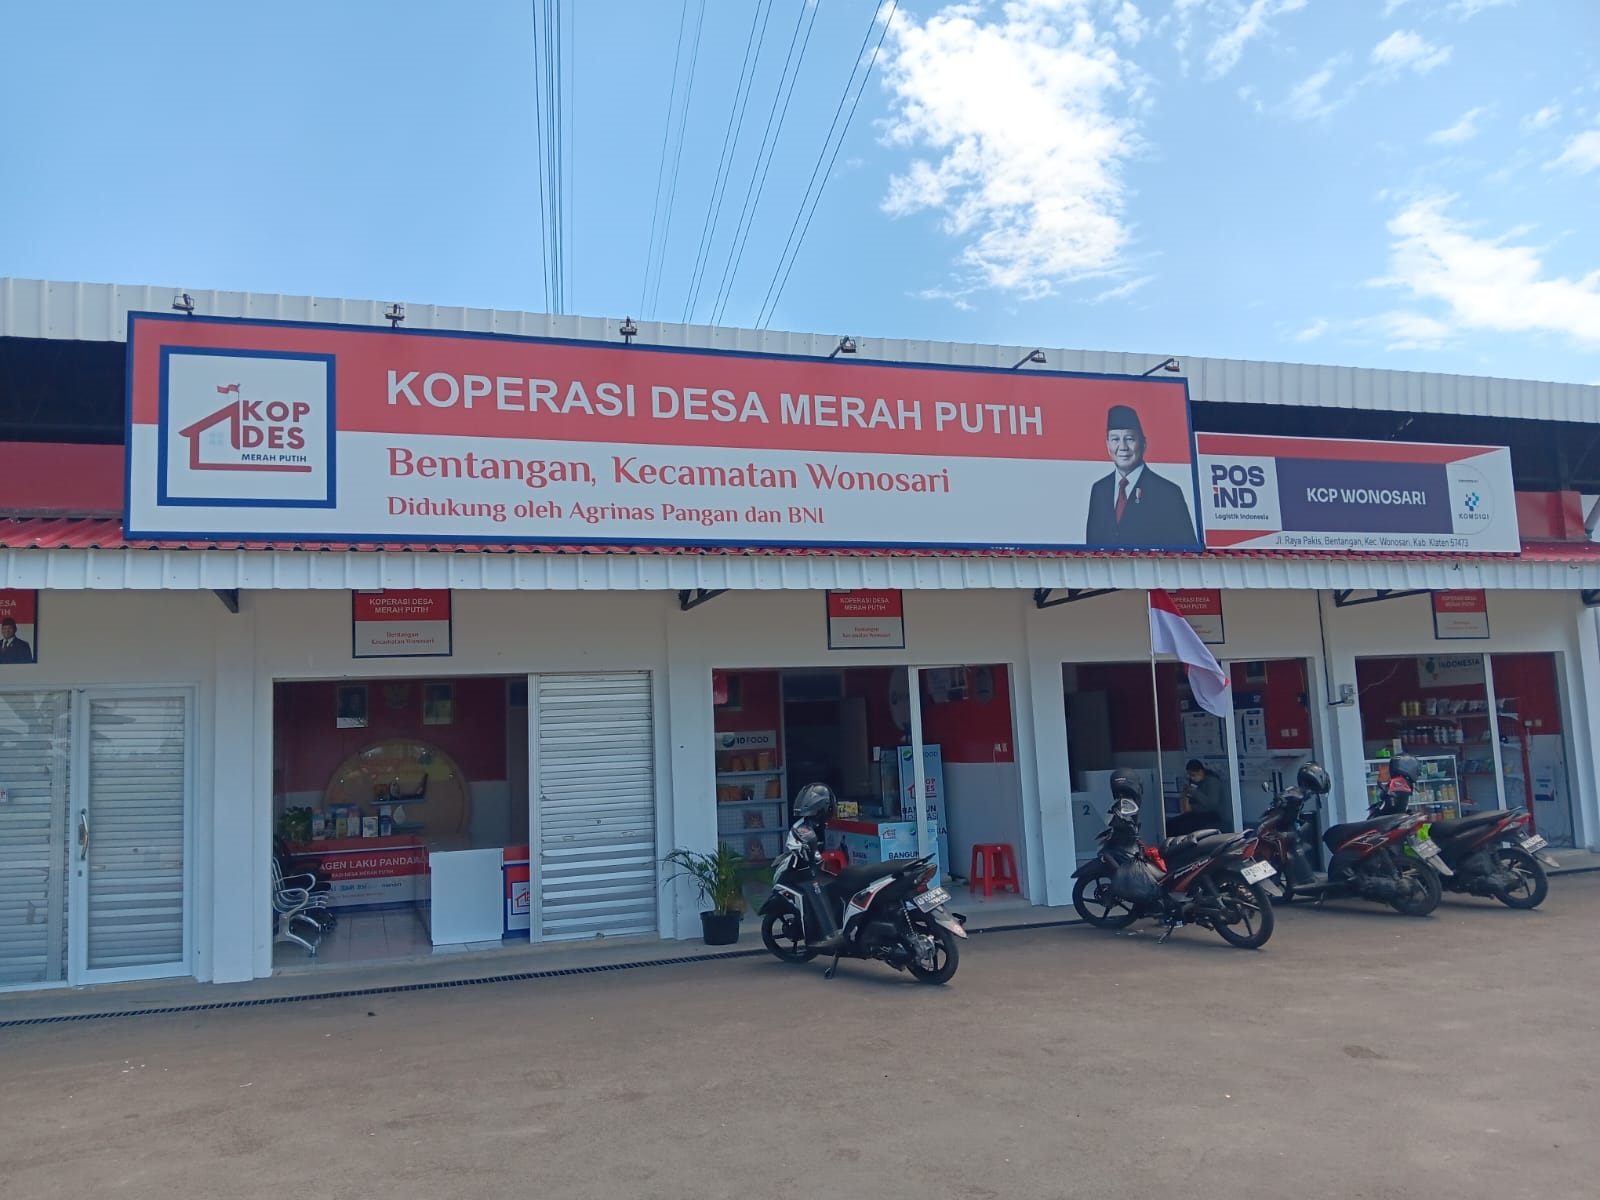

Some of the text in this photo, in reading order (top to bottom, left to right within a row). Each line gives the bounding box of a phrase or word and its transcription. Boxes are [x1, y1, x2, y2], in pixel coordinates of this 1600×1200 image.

[242, 400, 311, 422] KOP
[387, 369, 1043, 436] KOPERASI DESA MERAH PUTIH
[242, 425, 305, 449] DES
[241, 454, 307, 463] MERAH PUTIH
[386, 447, 950, 493] Bentangan, Kecamatan Wonosari
[1211, 464, 1265, 487] POS
[1306, 488, 1426, 505] KCP WONOSARI
[387, 496, 825, 527] Didukung oleh Agrinas Pangan dan BNI
[1215, 513, 1239, 521] Logistik
[1285, 536, 1301, 547] Raya
[369, 598, 411, 606] KOPERASI
[1082, 804, 1091, 816] 2
[320, 861, 347, 871] AGEN
[349, 859, 377, 869] LAKU
